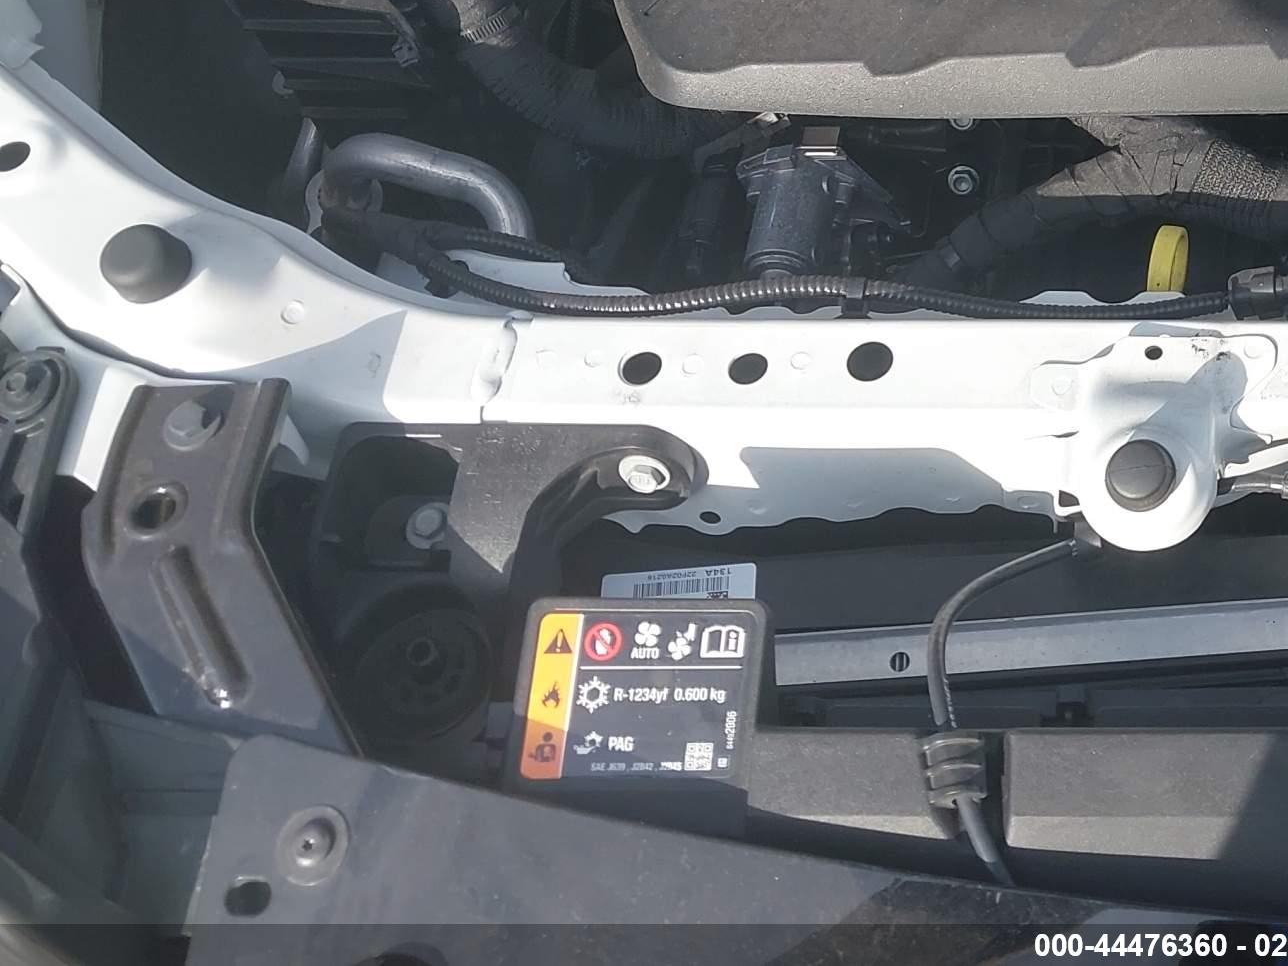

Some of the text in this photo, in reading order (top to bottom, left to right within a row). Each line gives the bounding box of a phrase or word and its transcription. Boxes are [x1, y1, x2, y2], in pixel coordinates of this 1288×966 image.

[705, 569, 732, 577] 134A
[631, 647, 660, 659] AUTO
[614, 687, 726, 703] R-1234yf 0.600 kg
[608, 736, 634, 751] PAG
